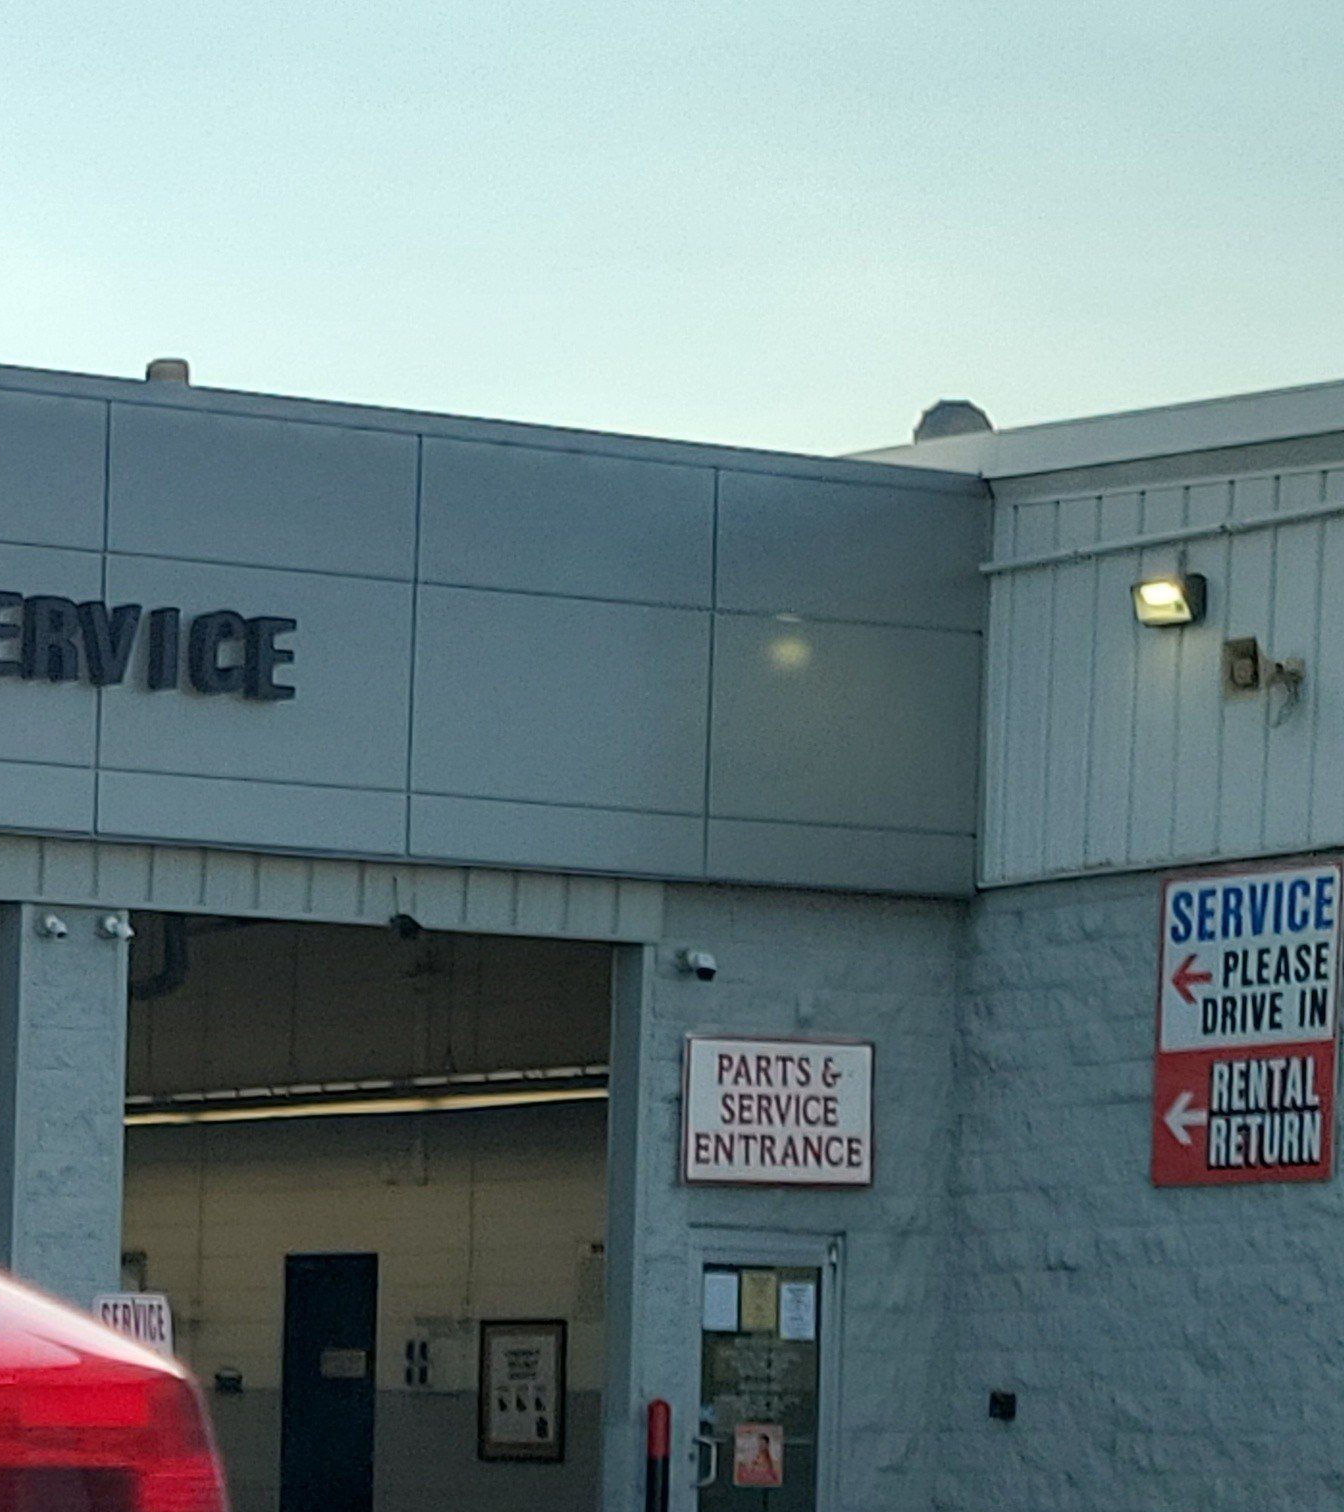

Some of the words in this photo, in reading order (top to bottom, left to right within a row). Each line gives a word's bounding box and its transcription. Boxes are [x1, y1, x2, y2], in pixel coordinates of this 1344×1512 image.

[1170, 875, 1335, 944] SERVICE
[1222, 942, 1330, 989] PLEASE
[1201, 991, 1283, 1036] DRIVE
[1297, 987, 1328, 1028] IN
[717, 1053, 812, 1088] PARTS
[821, 1055, 843, 1089] &
[1211, 1055, 1320, 1114] RENTAL
[720, 1092, 840, 1128] SERVICE
[694, 1131, 863, 1169] ENTRANCE
[1207, 1110, 1322, 1170] RETURN
